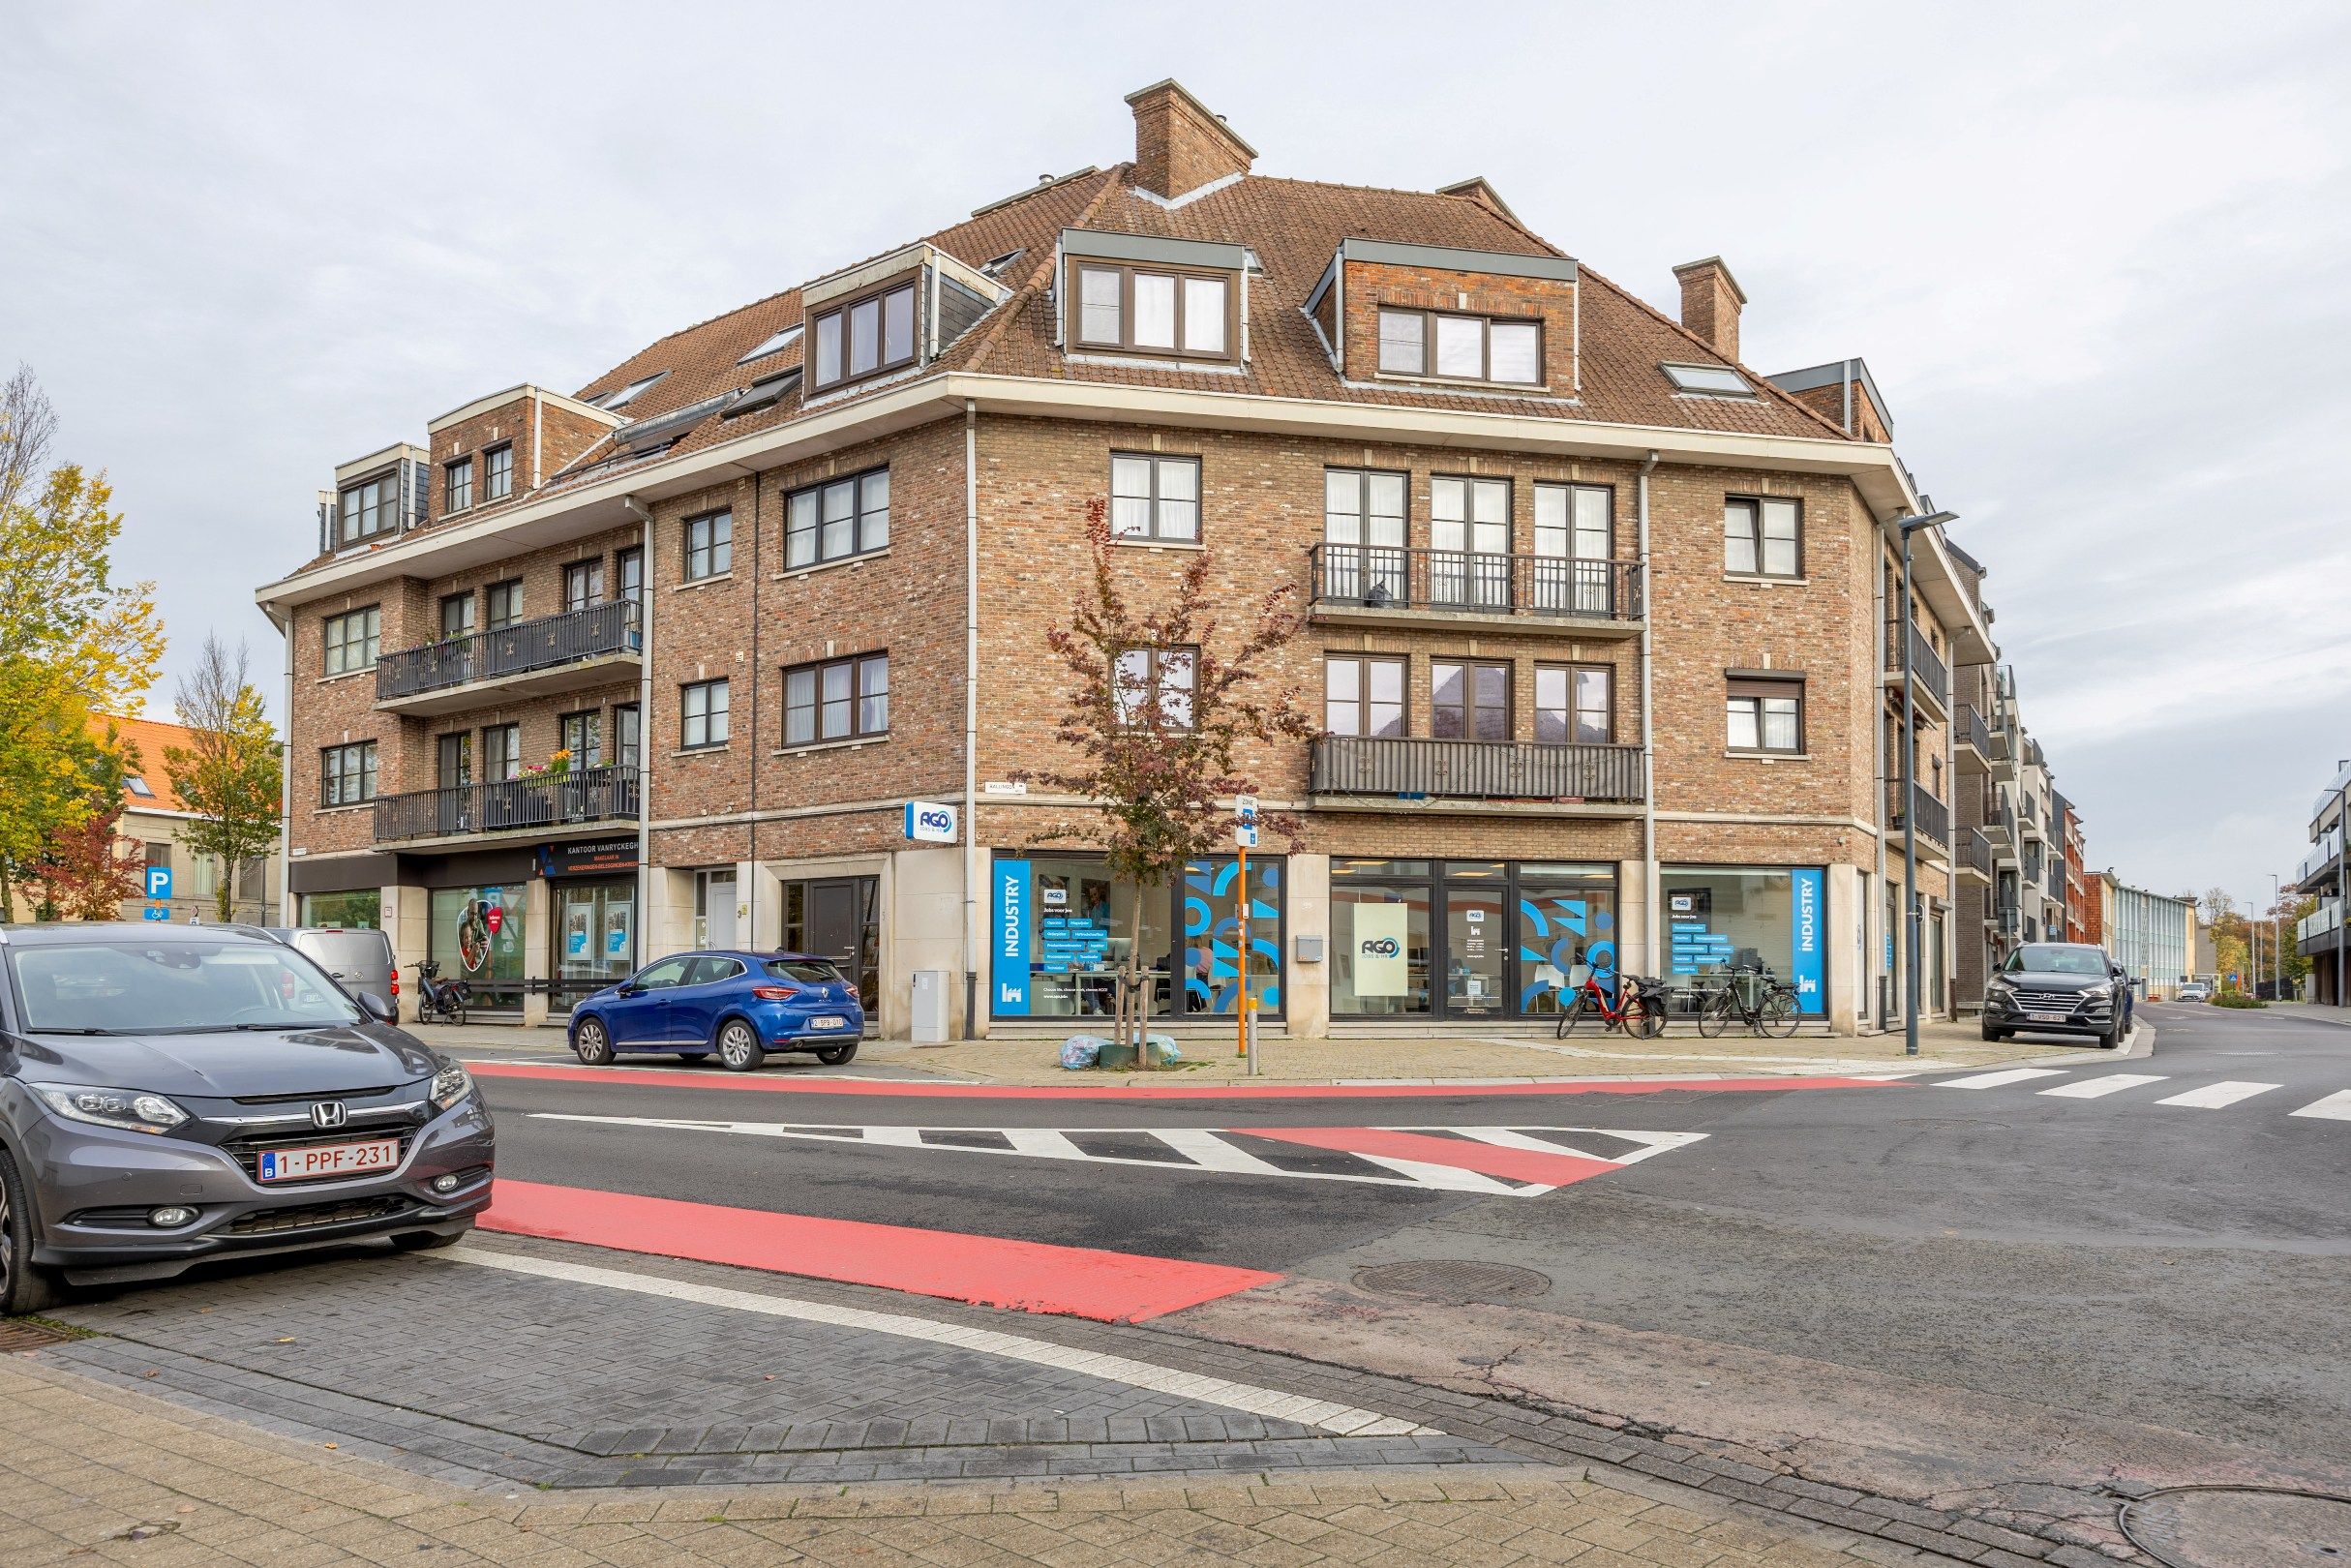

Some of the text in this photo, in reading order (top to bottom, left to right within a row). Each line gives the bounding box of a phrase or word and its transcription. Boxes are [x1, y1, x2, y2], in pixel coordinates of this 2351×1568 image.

[920, 811, 950, 829] AGO
[567, 841, 639, 855] KANTOOR VANRYCKEGH
[151, 872, 169, 894] P
[1046, 891, 1064, 900] AGO
[1005, 875, 1019, 957] INDUSTRY
[1801, 877, 1814, 951] INDUSTRY
[1362, 939, 1397, 954] AGO
[280, 1145, 390, 1174] 1-PPF-231
[264, 1167, 273, 1178] B
